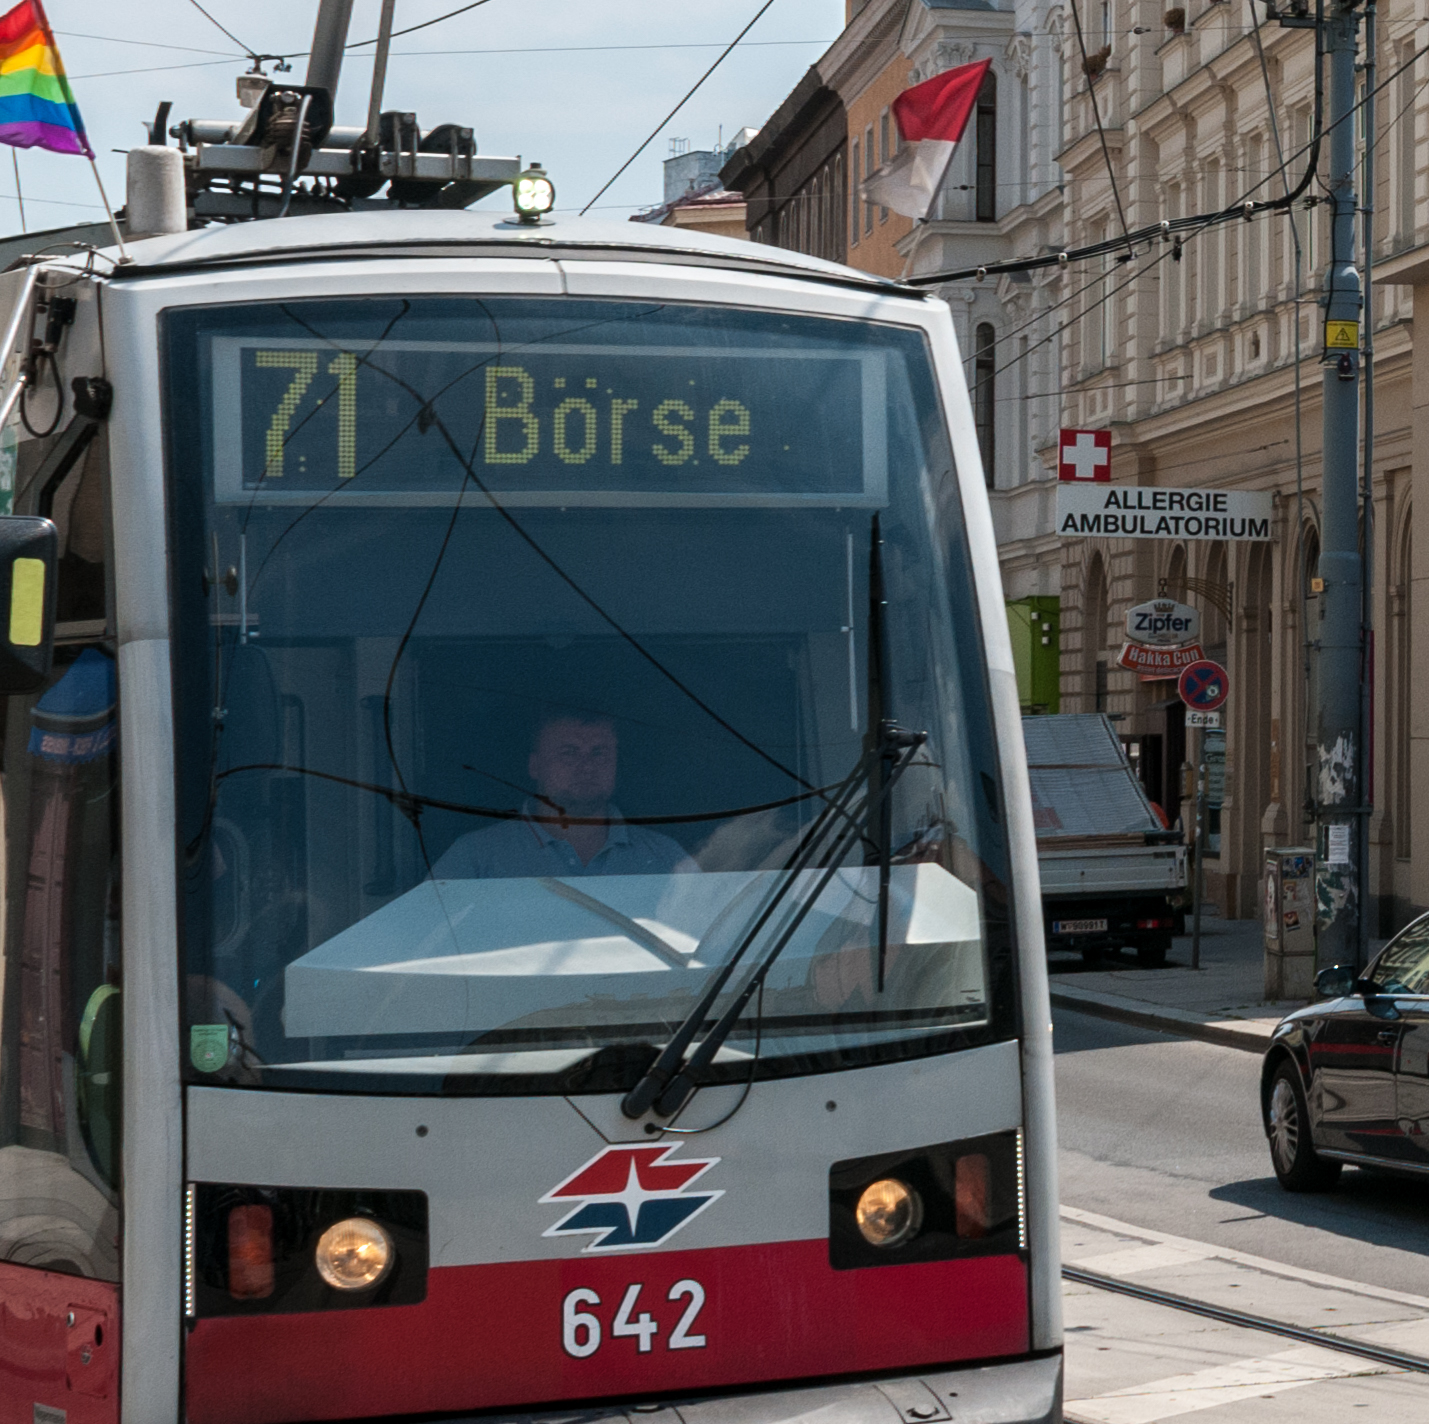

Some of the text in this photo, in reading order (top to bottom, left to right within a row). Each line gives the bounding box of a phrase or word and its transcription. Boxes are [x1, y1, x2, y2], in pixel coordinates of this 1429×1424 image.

[255, 350, 752, 479] 71 Börse
[1103, 490, 1229, 513] ALLERGIE
[1061, 512, 1270, 538] AMBULATORIUM
[1134, 612, 1192, 635] Zipfer
[1128, 647, 1171, 666] Hakka
[1191, 713, 1214, 725] Ende
[560, 1279, 706, 1358] 642
